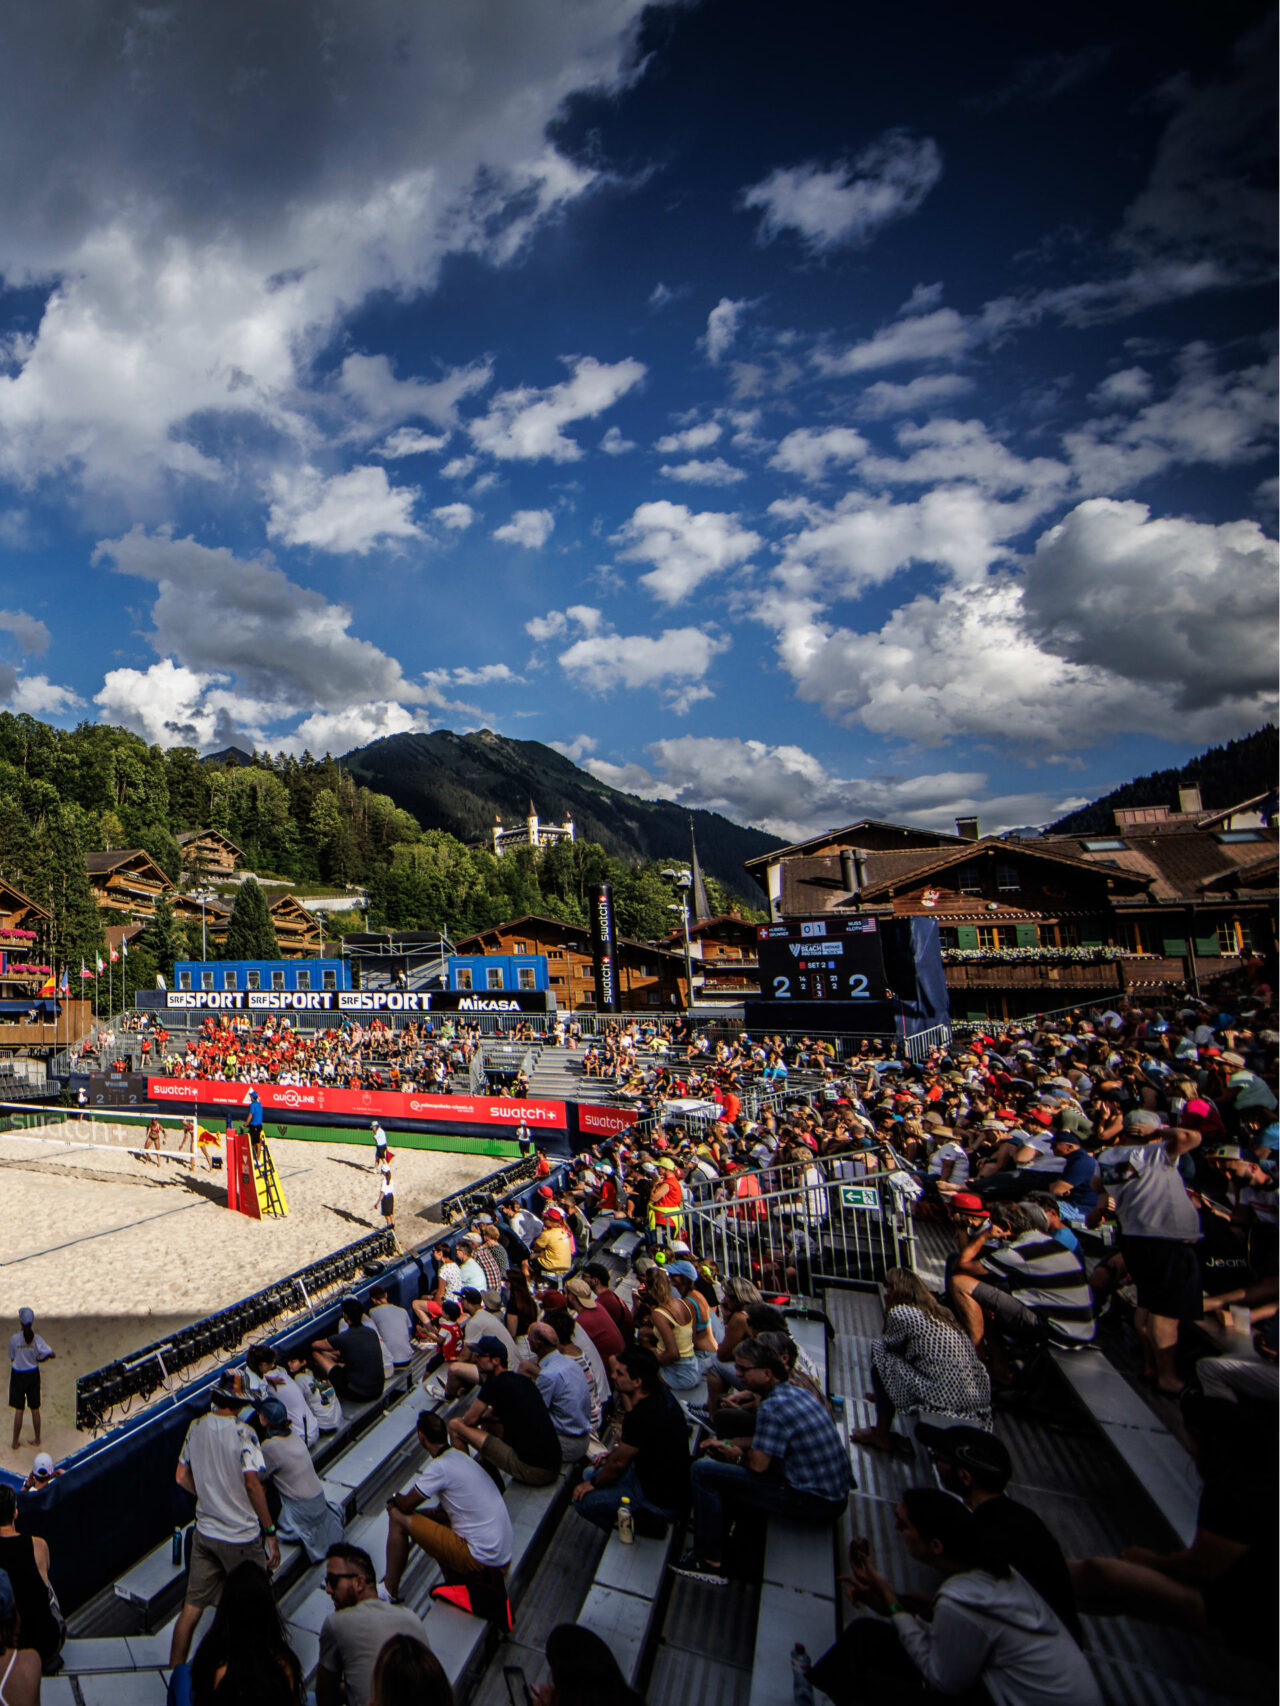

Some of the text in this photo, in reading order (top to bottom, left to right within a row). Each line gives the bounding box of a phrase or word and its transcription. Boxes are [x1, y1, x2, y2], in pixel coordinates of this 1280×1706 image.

[598, 901, 610, 941] swatch
[817, 924, 822, 933] 1
[803, 925, 811, 934] 0
[602, 963, 613, 1004] swatch
[773, 976, 791, 998] 2
[849, 974, 870, 997] 2
[169, 992, 245, 1008] SRF SPORT
[251, 992, 333, 1009] SRF SPORT
[341, 993, 433, 1010] SRF SPORT
[153, 1084, 193, 1096] swatch
[96, 1094, 104, 1104] 2
[129, 1094, 137, 1104] 2
[490, 1106, 546, 1120] swatch
[10, 1113, 109, 1142] swatch
[585, 1114, 624, 1130] swatch
